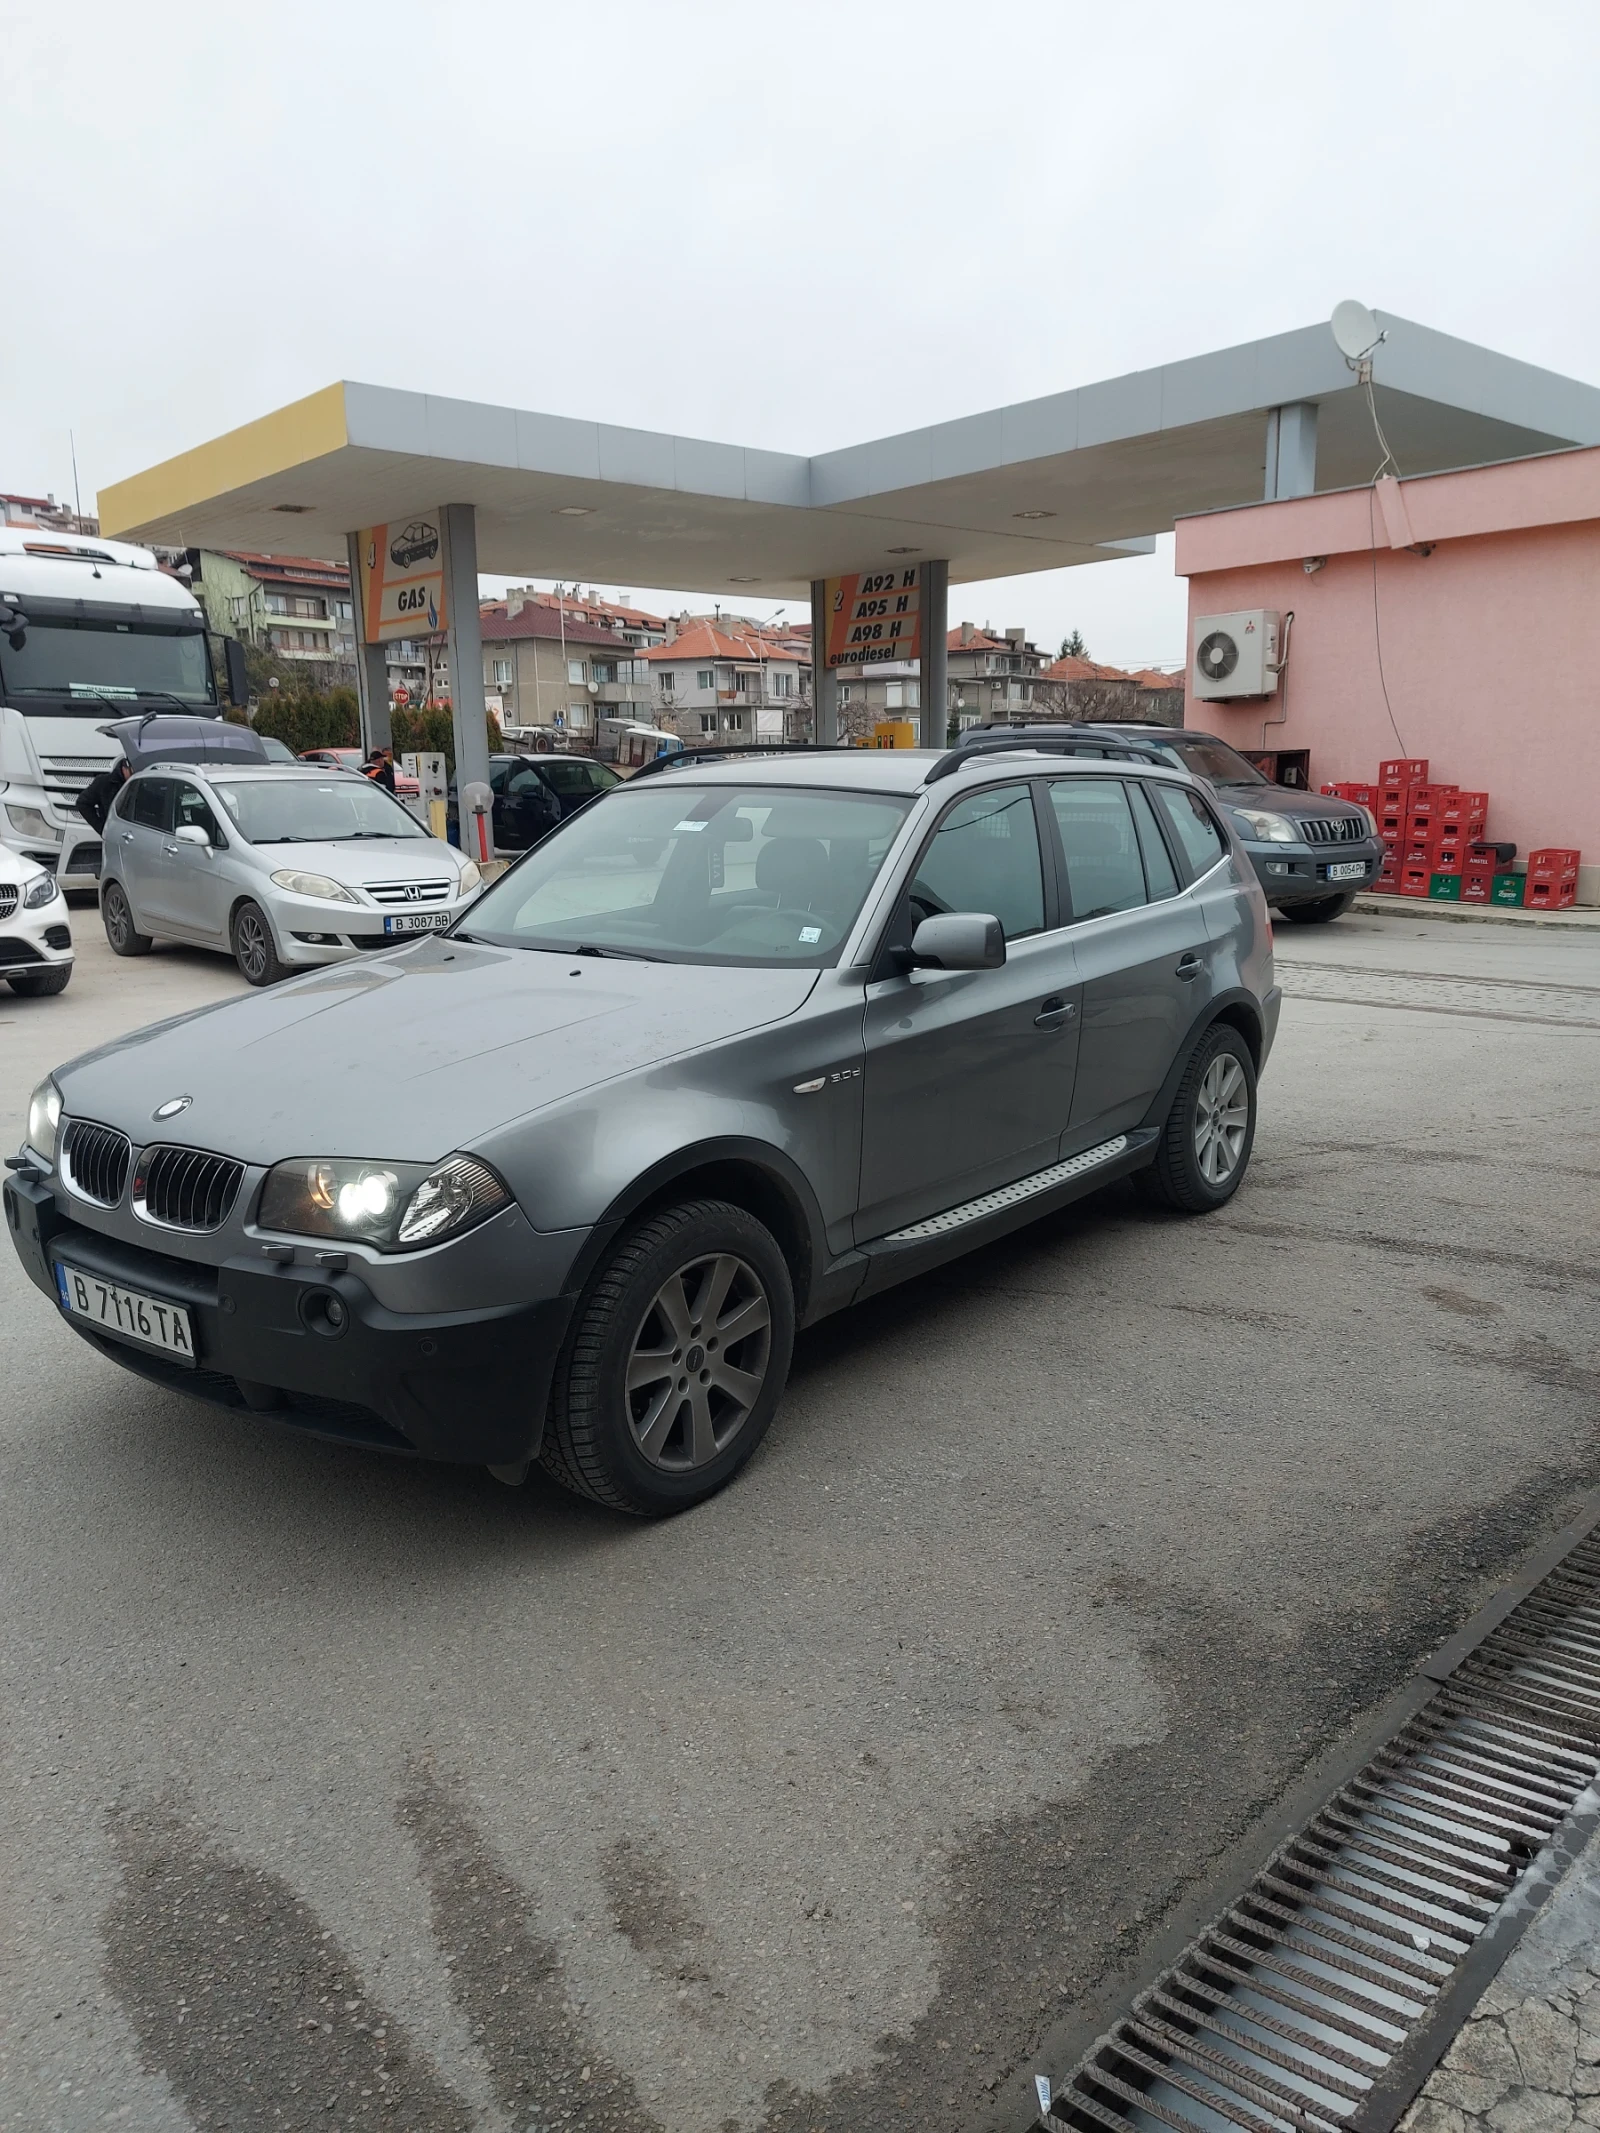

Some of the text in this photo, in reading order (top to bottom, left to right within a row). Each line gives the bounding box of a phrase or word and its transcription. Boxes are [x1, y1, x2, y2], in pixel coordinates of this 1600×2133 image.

[862, 569, 915, 594] A92 H
[398, 586, 426, 611] GAS
[833, 589, 844, 612] 2
[856, 595, 908, 618] A95 H
[851, 620, 902, 642] A98 H
[830, 642, 896, 665] eurodiesel
[396, 918, 404, 930] B
[408, 916, 433, 929] 3087
[435, 915, 448, 927] BB
[74, 1275, 189, 1350] B 7116 TA
